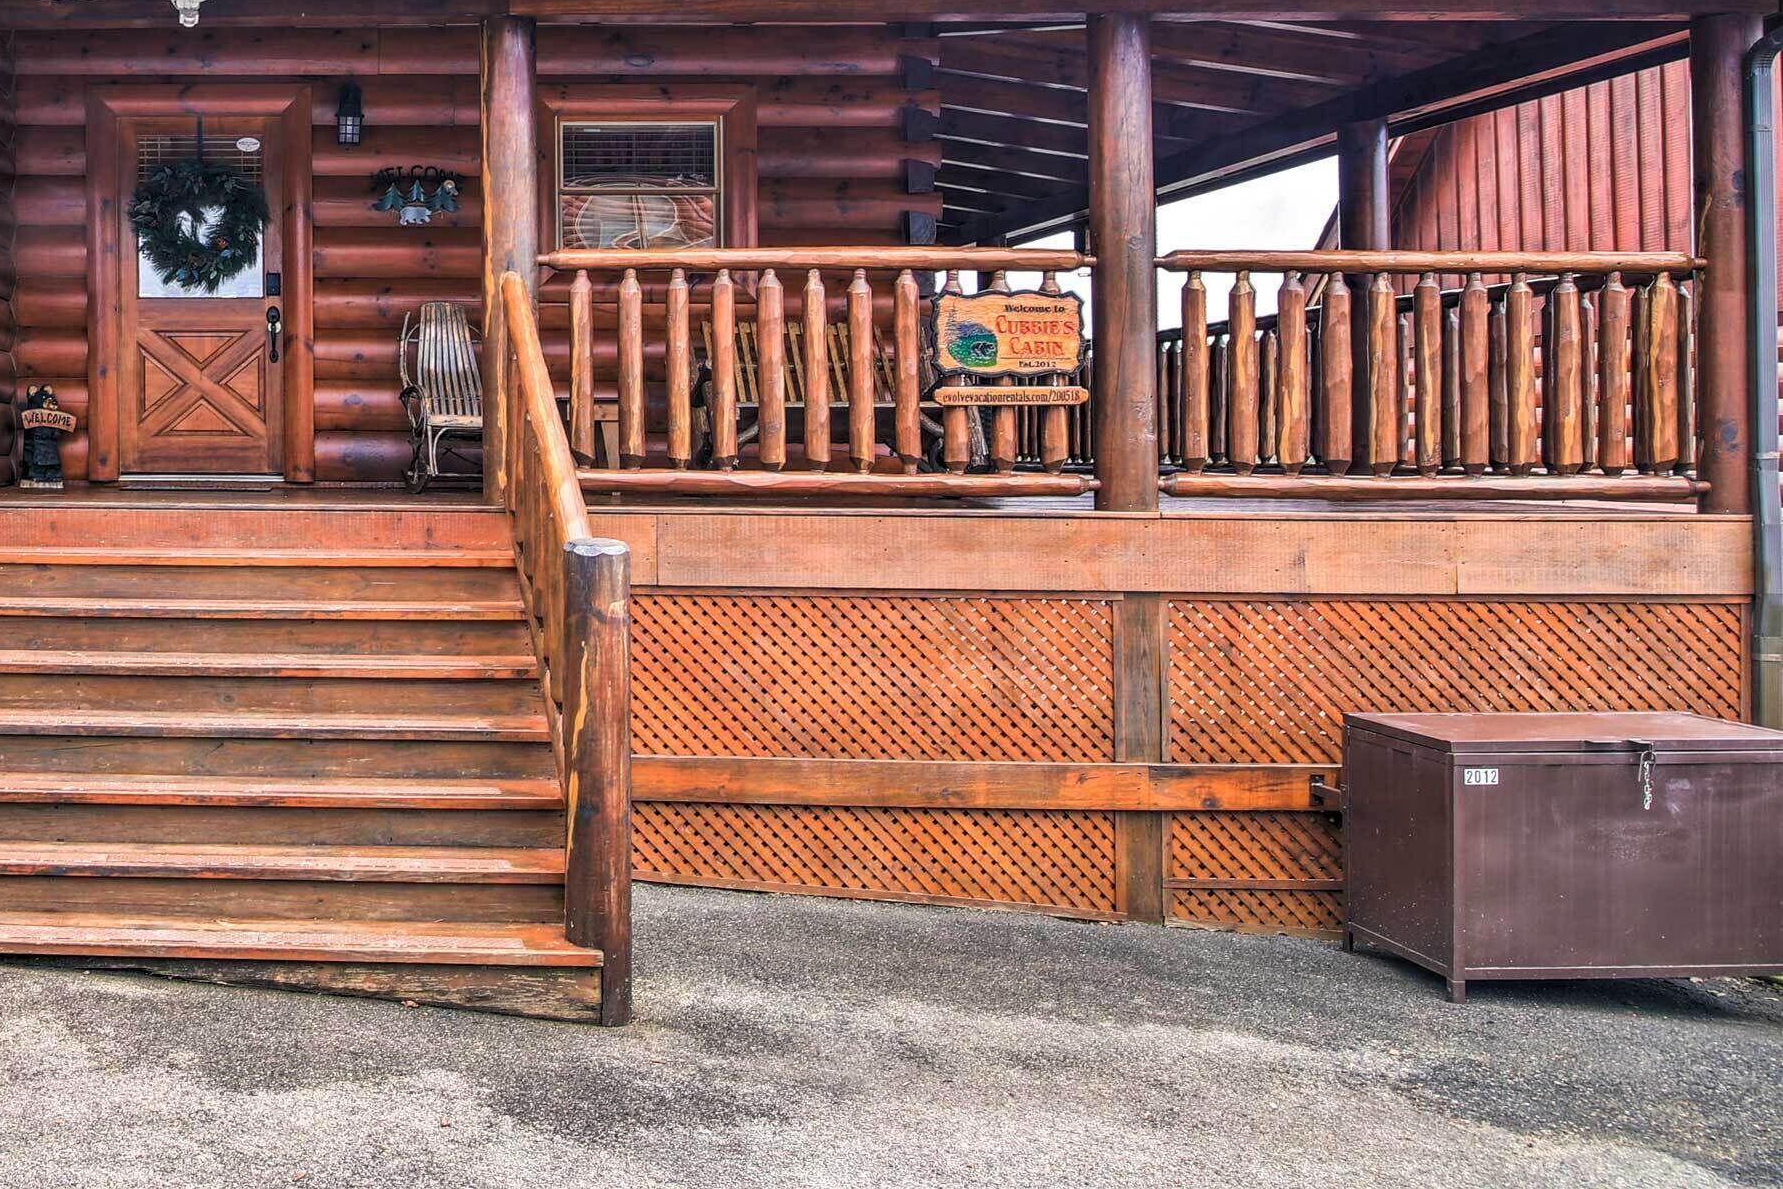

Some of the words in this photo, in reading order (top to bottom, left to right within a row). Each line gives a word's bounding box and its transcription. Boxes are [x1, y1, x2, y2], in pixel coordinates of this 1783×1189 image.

[1005, 305, 1051, 313] Welcome
[1054, 305, 1065, 313] to
[1009, 337, 1064, 356] CABIN
[24, 412, 72, 426] WELCOME
[1466, 770, 1497, 783] 2012
